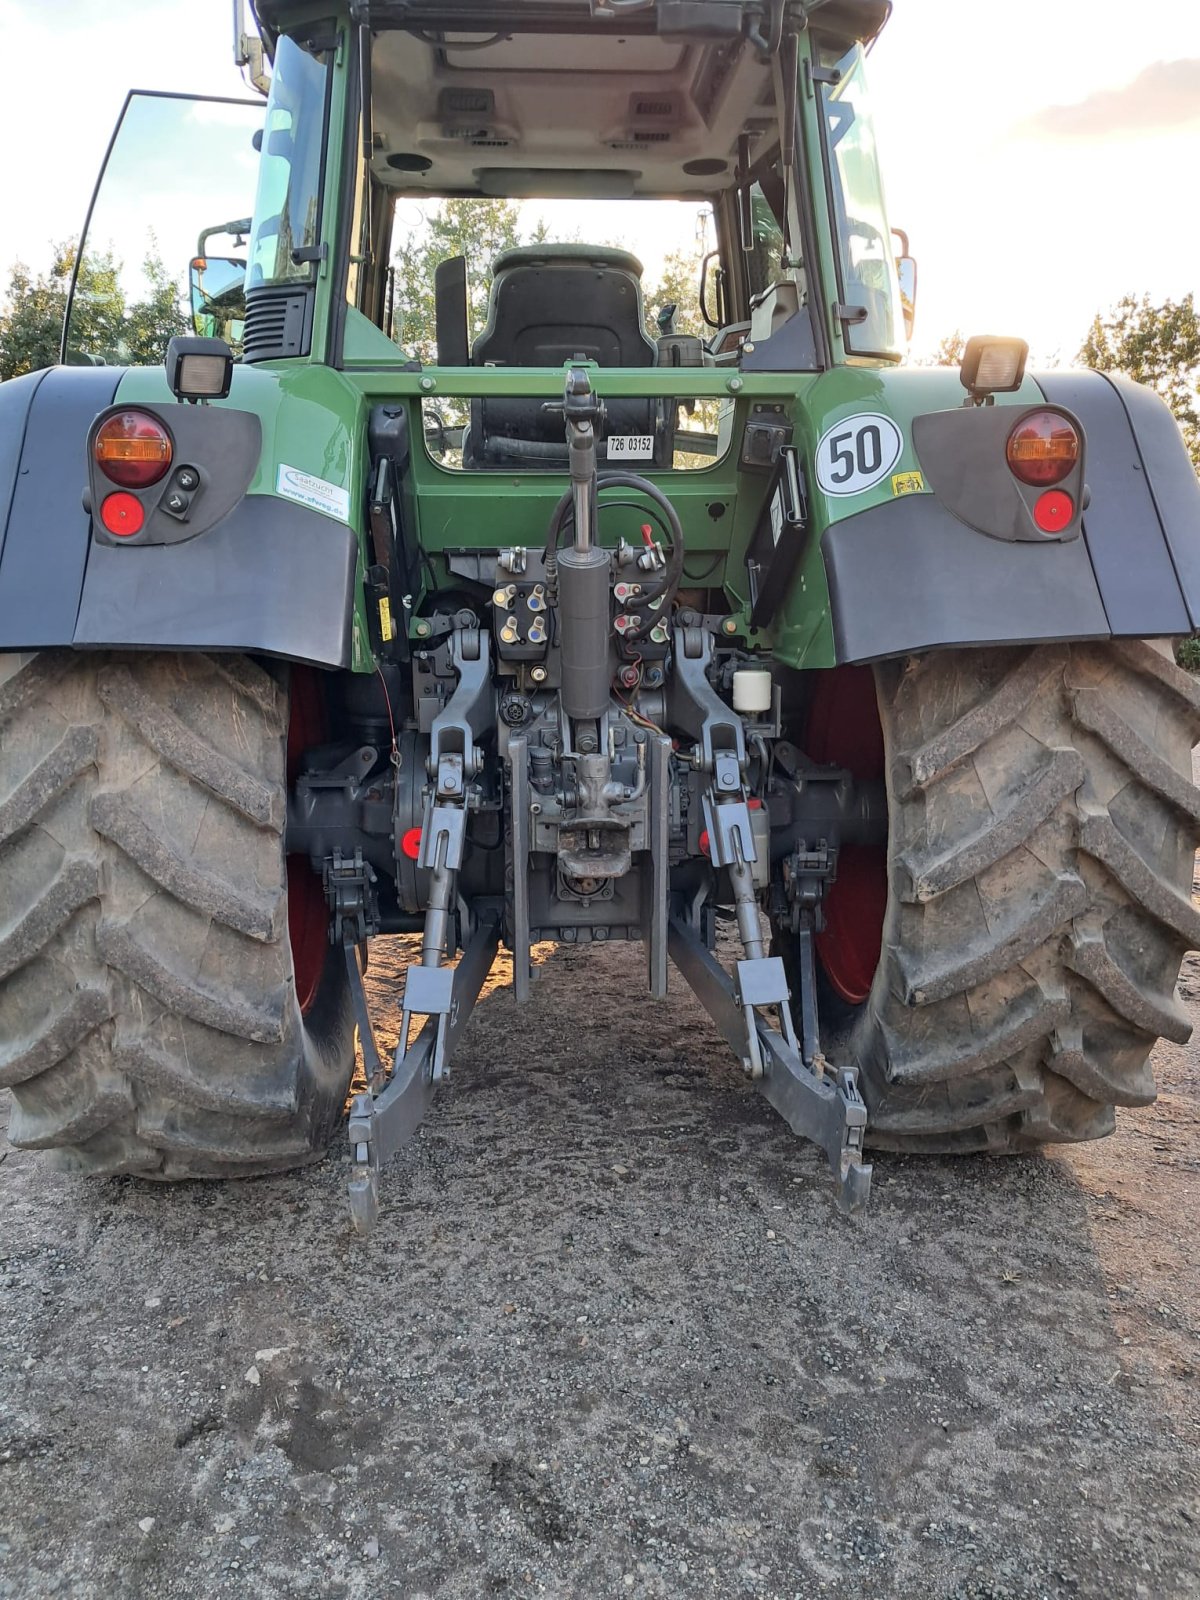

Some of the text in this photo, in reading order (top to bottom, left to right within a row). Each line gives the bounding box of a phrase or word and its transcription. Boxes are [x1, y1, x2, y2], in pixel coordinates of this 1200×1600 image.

[611, 438, 651, 451] 726 03152
[829, 425, 882, 484] 50
[294, 473, 333, 495] Saatzucht
